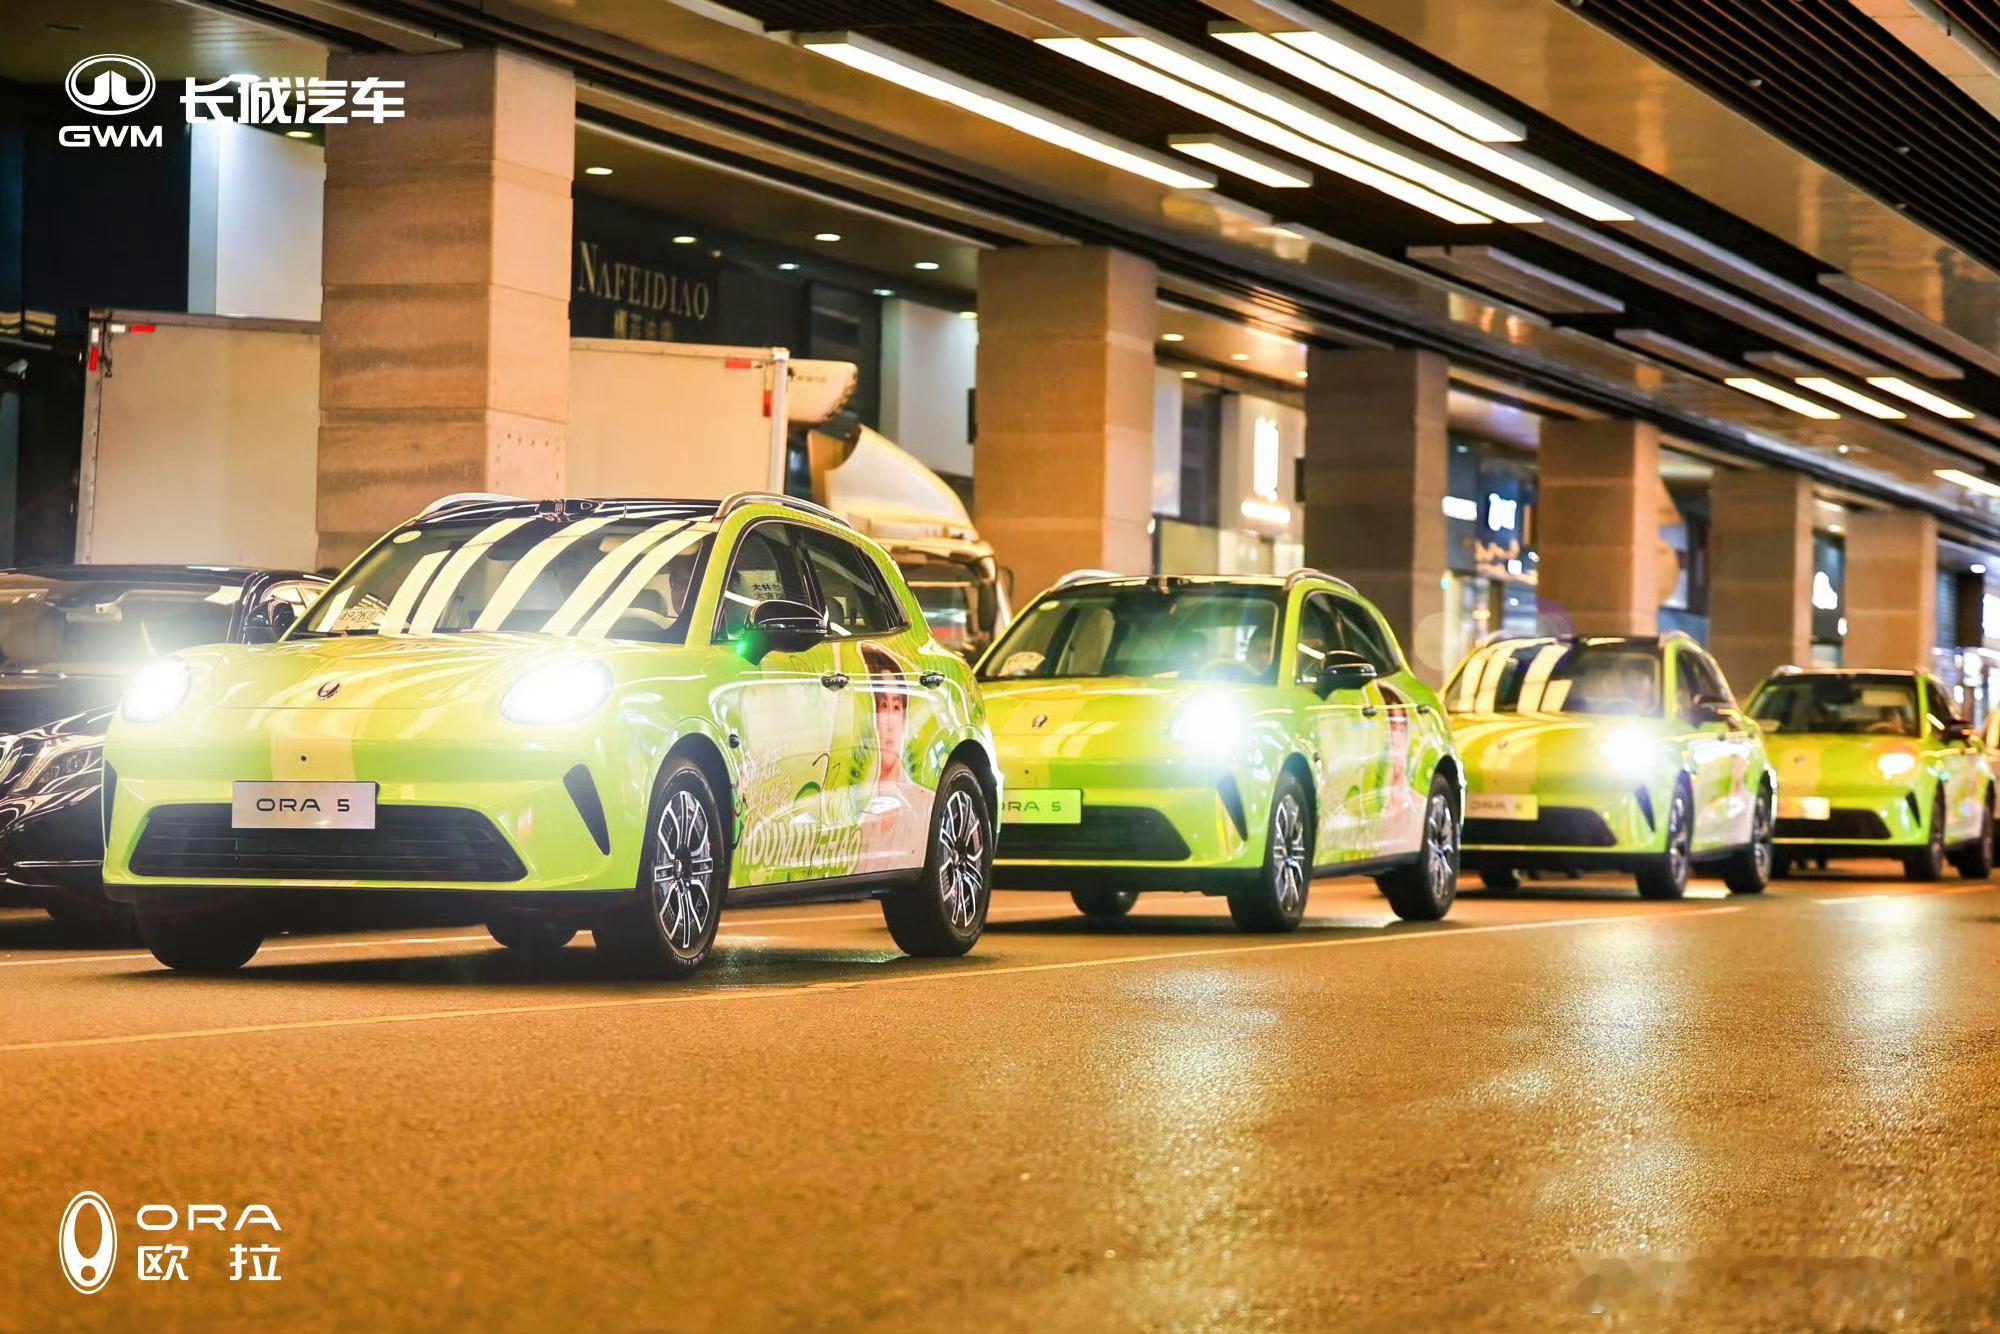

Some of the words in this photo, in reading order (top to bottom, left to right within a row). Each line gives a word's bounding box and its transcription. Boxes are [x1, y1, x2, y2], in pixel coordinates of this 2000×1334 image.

[577, 240, 709, 320] NAFEIDIAO
[256, 798, 321, 812] ORA
[337, 798, 350, 812] 5
[1002, 801, 1040, 812] RA
